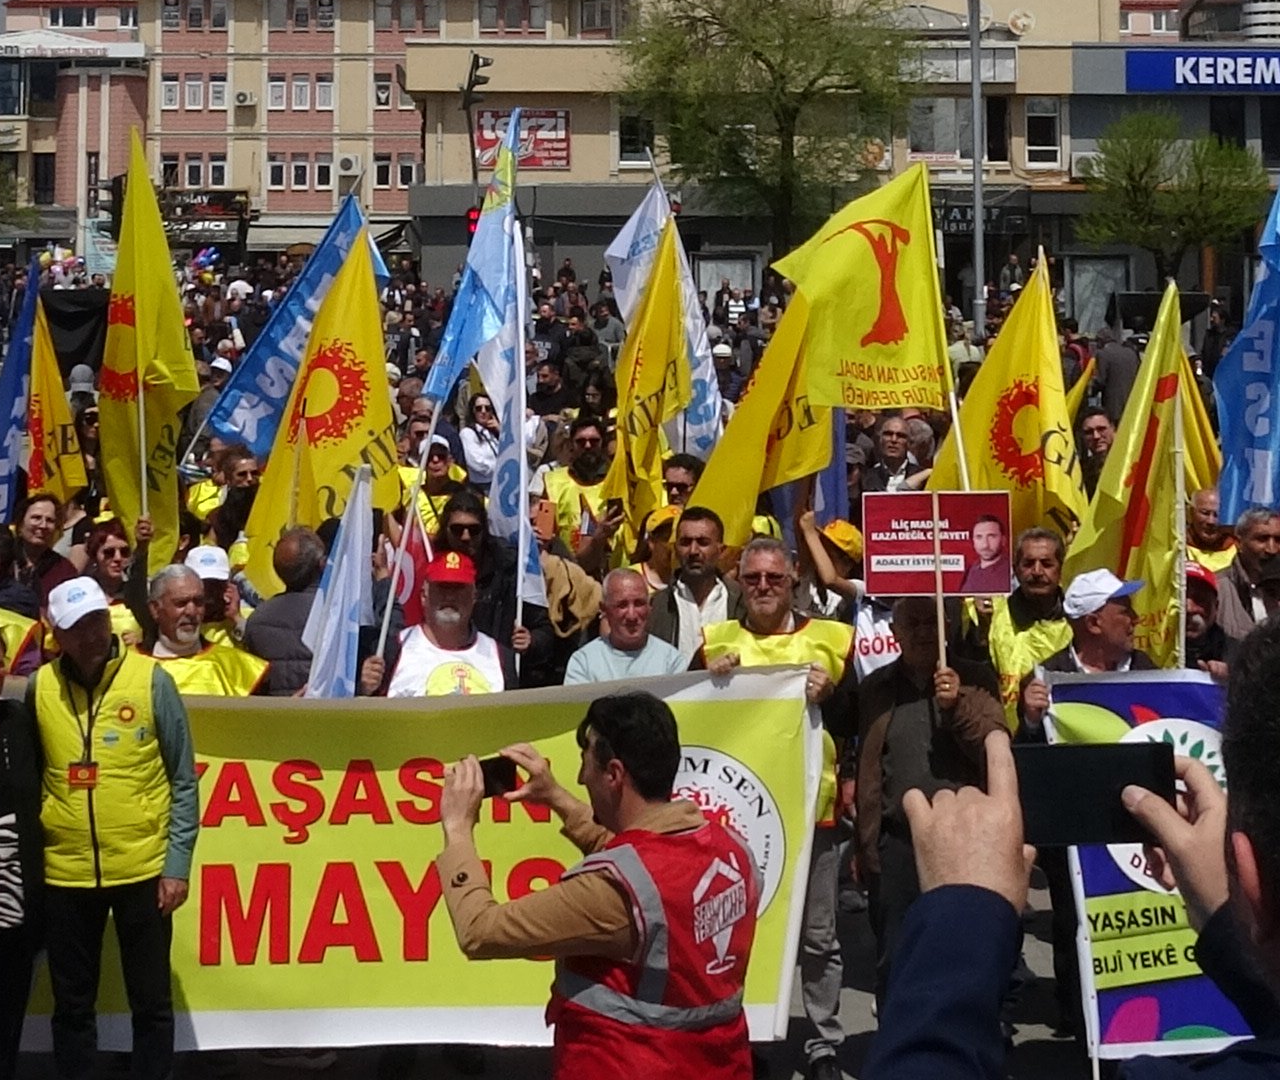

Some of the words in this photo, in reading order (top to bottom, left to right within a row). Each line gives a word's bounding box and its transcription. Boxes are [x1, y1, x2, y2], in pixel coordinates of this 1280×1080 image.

[871, 531, 898, 542] KAZA
[875, 557, 911, 567] ADALET
[717, 763, 772, 821] SEN
[1087, 905, 1178, 935] YAŞASIN
[1127, 943, 1179, 971] YEKÊ
